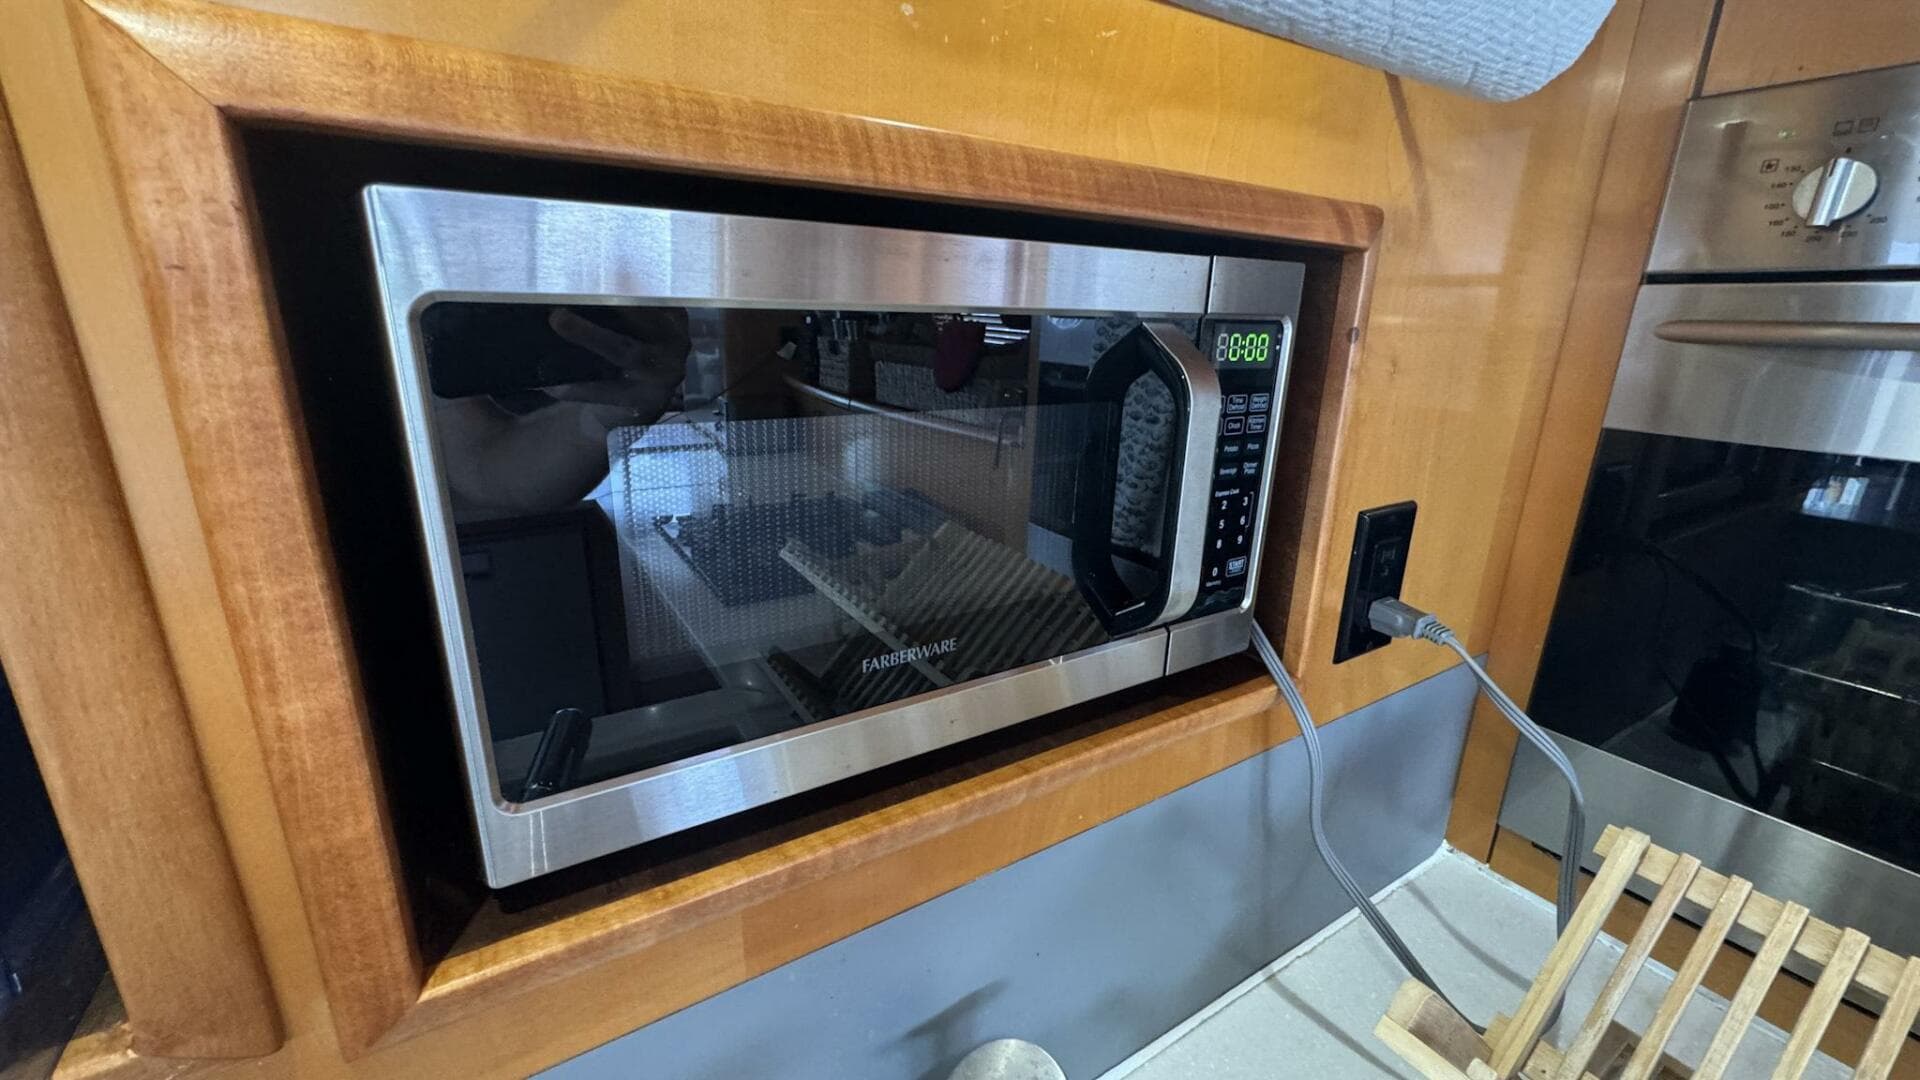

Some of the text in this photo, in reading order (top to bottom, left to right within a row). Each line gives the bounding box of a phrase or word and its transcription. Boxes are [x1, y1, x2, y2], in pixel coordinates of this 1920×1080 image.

[1221, 500, 1228, 510] 2
[1242, 496, 1249, 506] 3
[1219, 519, 1225, 529] 5
[1240, 515, 1246, 526] 6
[1216, 539, 1222, 549] 8
[1237, 535, 1243, 545] 9
[1212, 567, 1218, 577] 0
[862, 637, 957, 673] FARBERWARE
